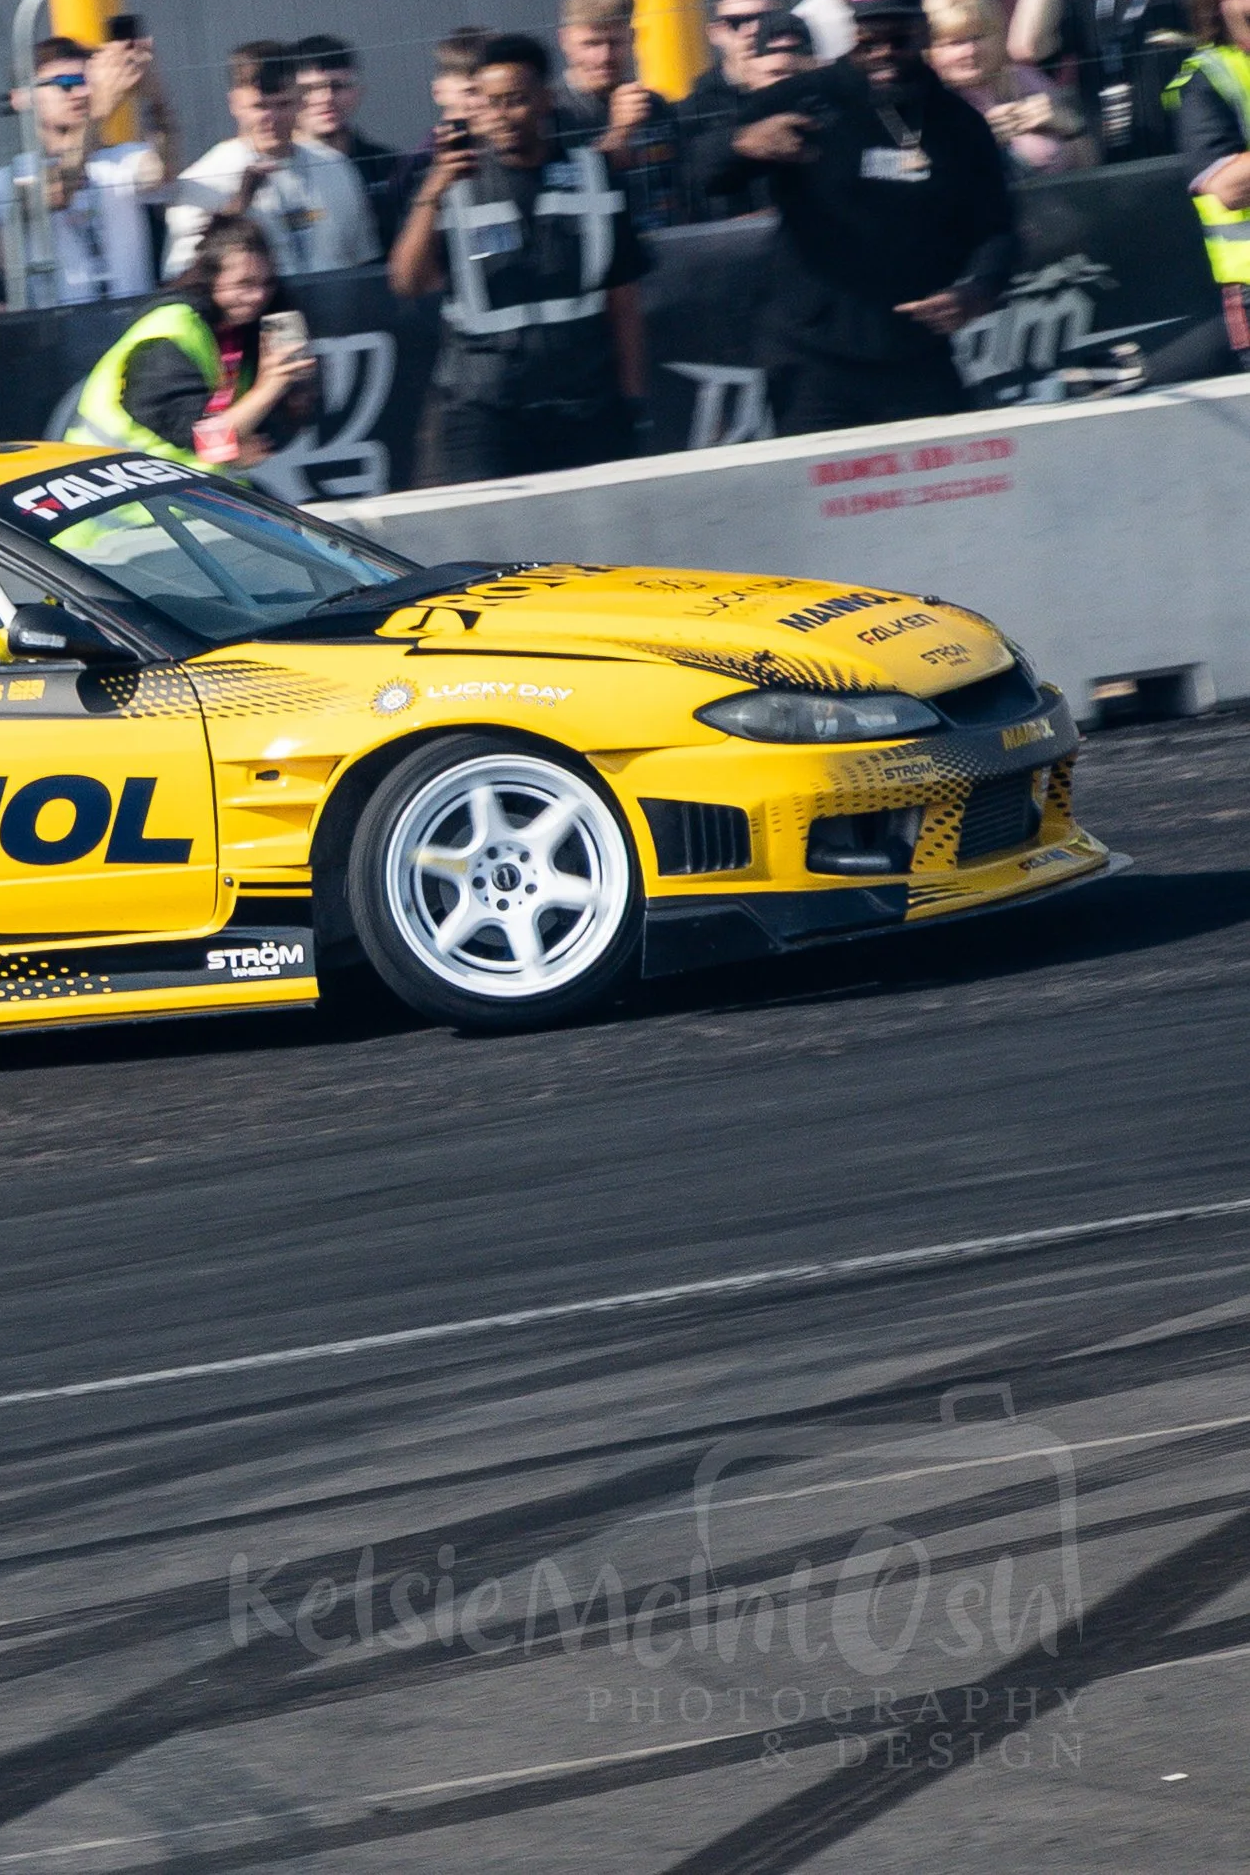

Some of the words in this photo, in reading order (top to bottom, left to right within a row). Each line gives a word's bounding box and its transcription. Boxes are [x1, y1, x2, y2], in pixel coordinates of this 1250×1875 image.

[12, 458, 210, 521] FALKEN
[856, 612, 939, 646] FALKEN
[426, 681, 515, 698] LUCKY
[518, 683, 573, 701] DAY
[206, 941, 304, 970] STRÖM
